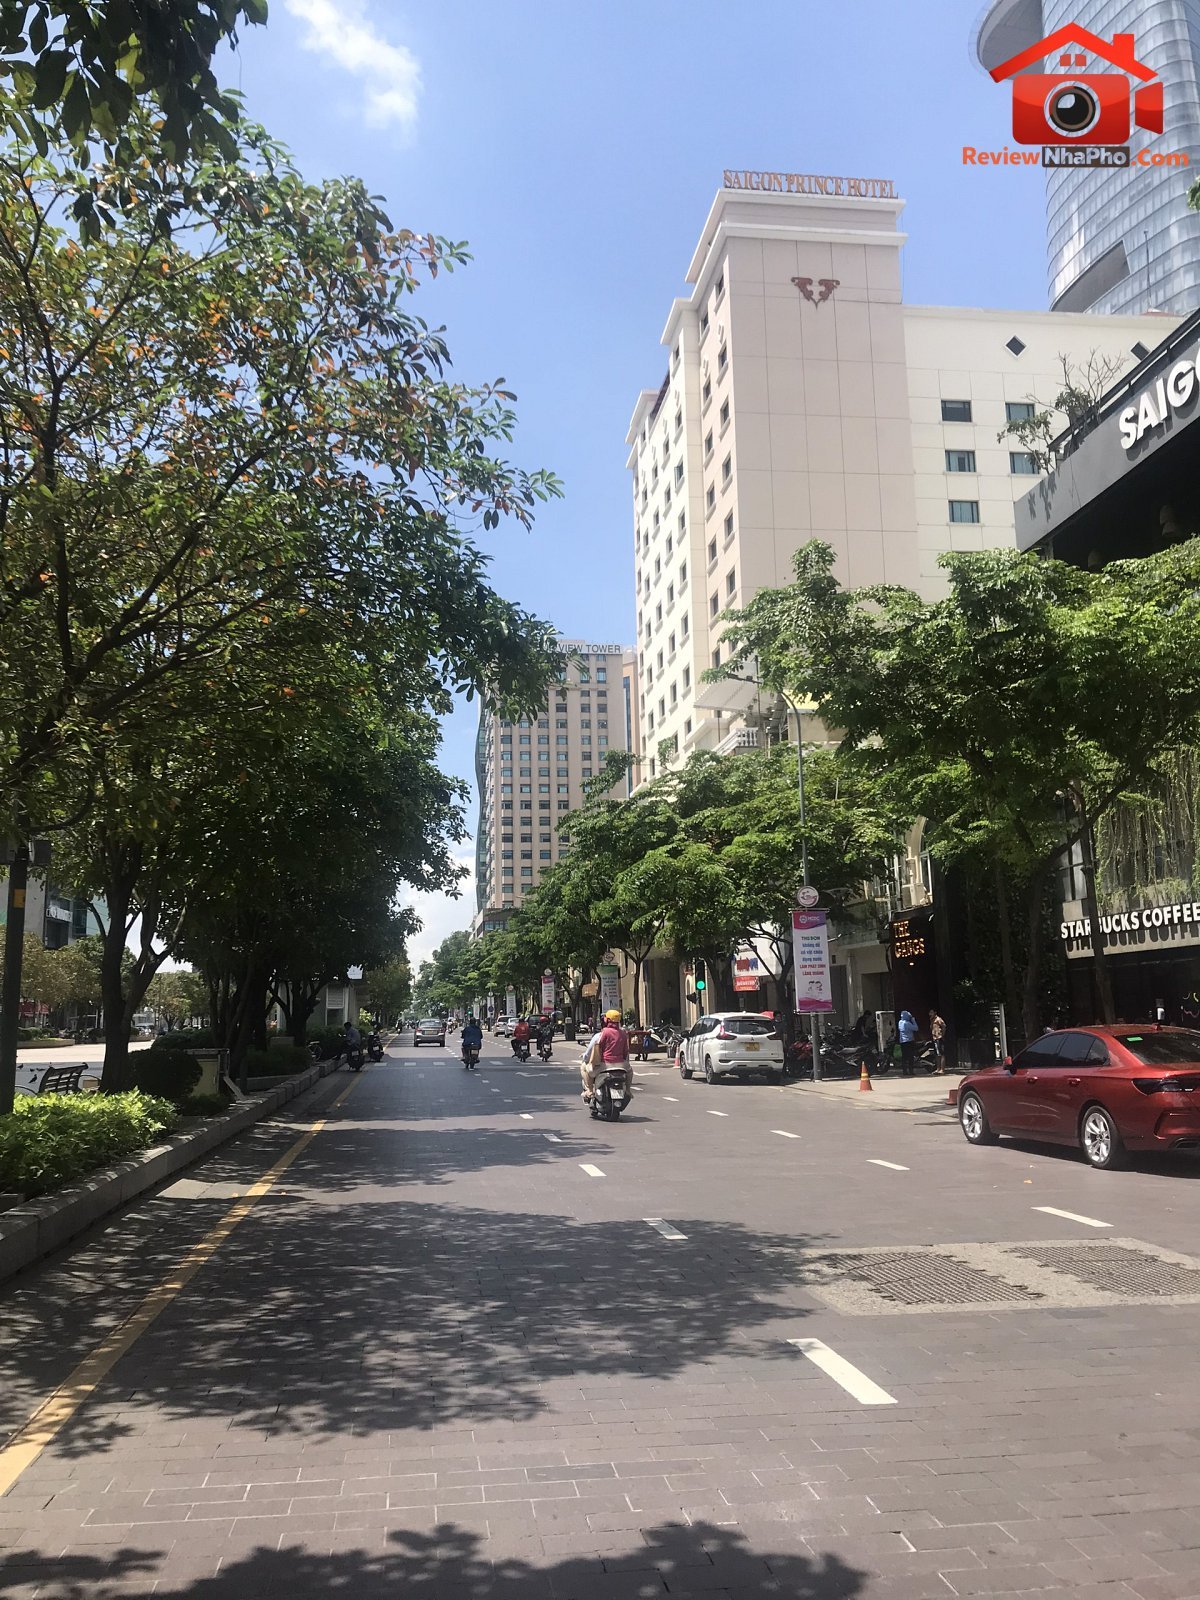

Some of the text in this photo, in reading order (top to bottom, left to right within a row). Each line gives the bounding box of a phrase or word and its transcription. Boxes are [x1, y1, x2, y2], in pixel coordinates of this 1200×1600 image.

[723, 170, 899, 199] SAIGON PRINCE HOTEL
[1119, 342, 1200, 450] SAIG
[558, 644, 583, 653] VIEW
[586, 644, 621, 653] TOWER
[1142, 902, 1200, 928] COFFEE
[893, 921, 910, 938] THE
[895, 938, 925, 958] GANGS
